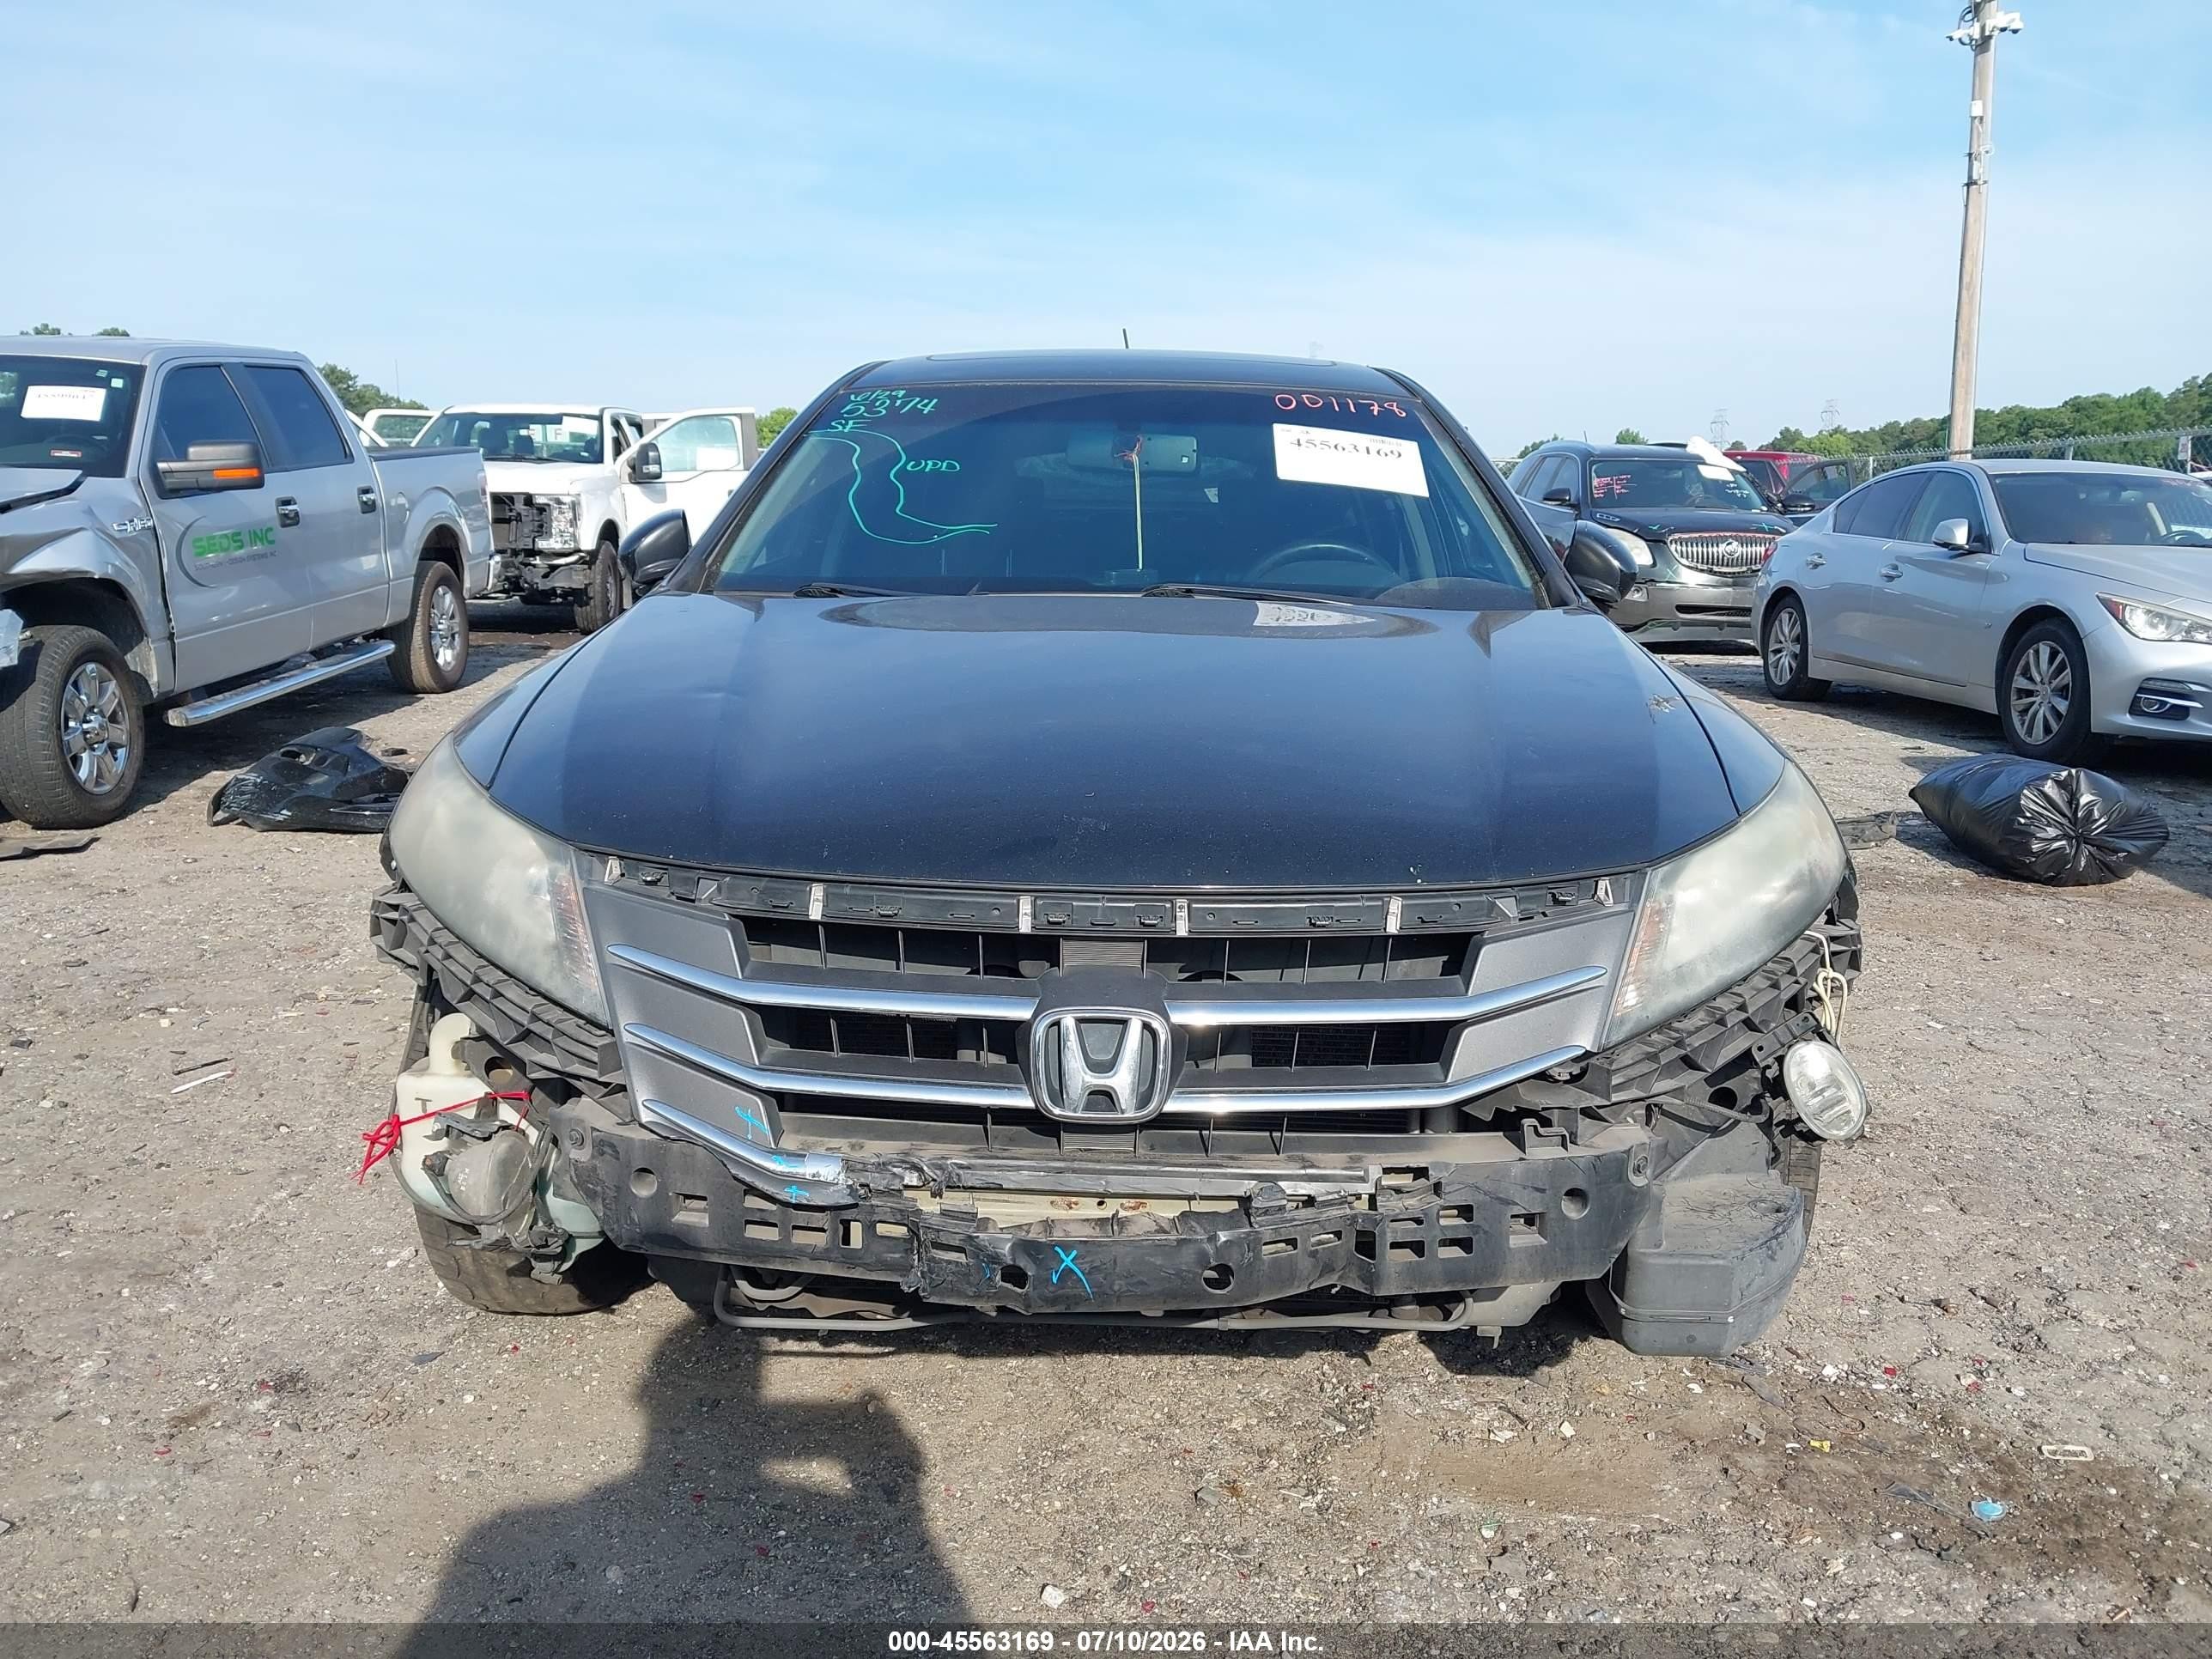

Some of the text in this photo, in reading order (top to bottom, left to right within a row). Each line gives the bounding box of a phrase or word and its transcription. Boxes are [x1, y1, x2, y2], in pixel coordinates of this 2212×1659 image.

[1289, 438, 1402, 459] 45563169
[191, 526, 276, 556] SEDS INC
